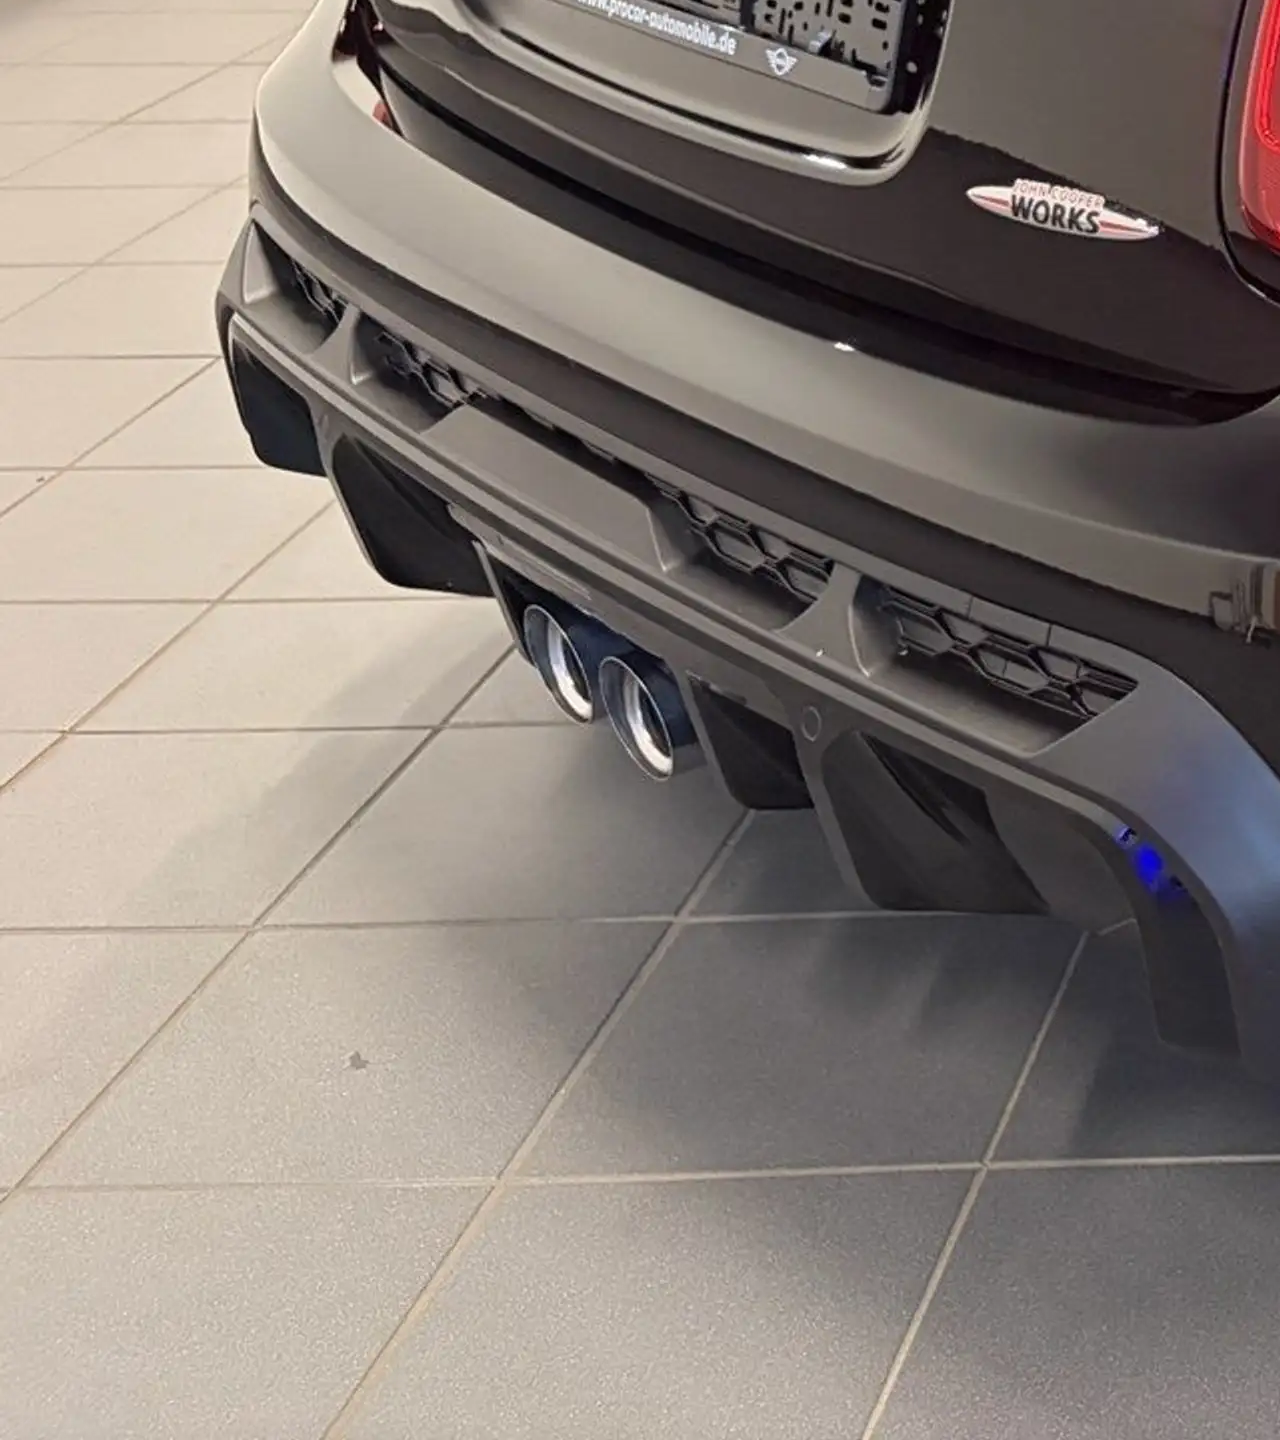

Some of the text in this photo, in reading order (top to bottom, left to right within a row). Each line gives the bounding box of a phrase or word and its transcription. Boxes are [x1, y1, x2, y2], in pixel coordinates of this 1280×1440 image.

[1013, 181, 1105, 207] JOHN COOPER
[1010, 194, 1101, 234] WORKS
